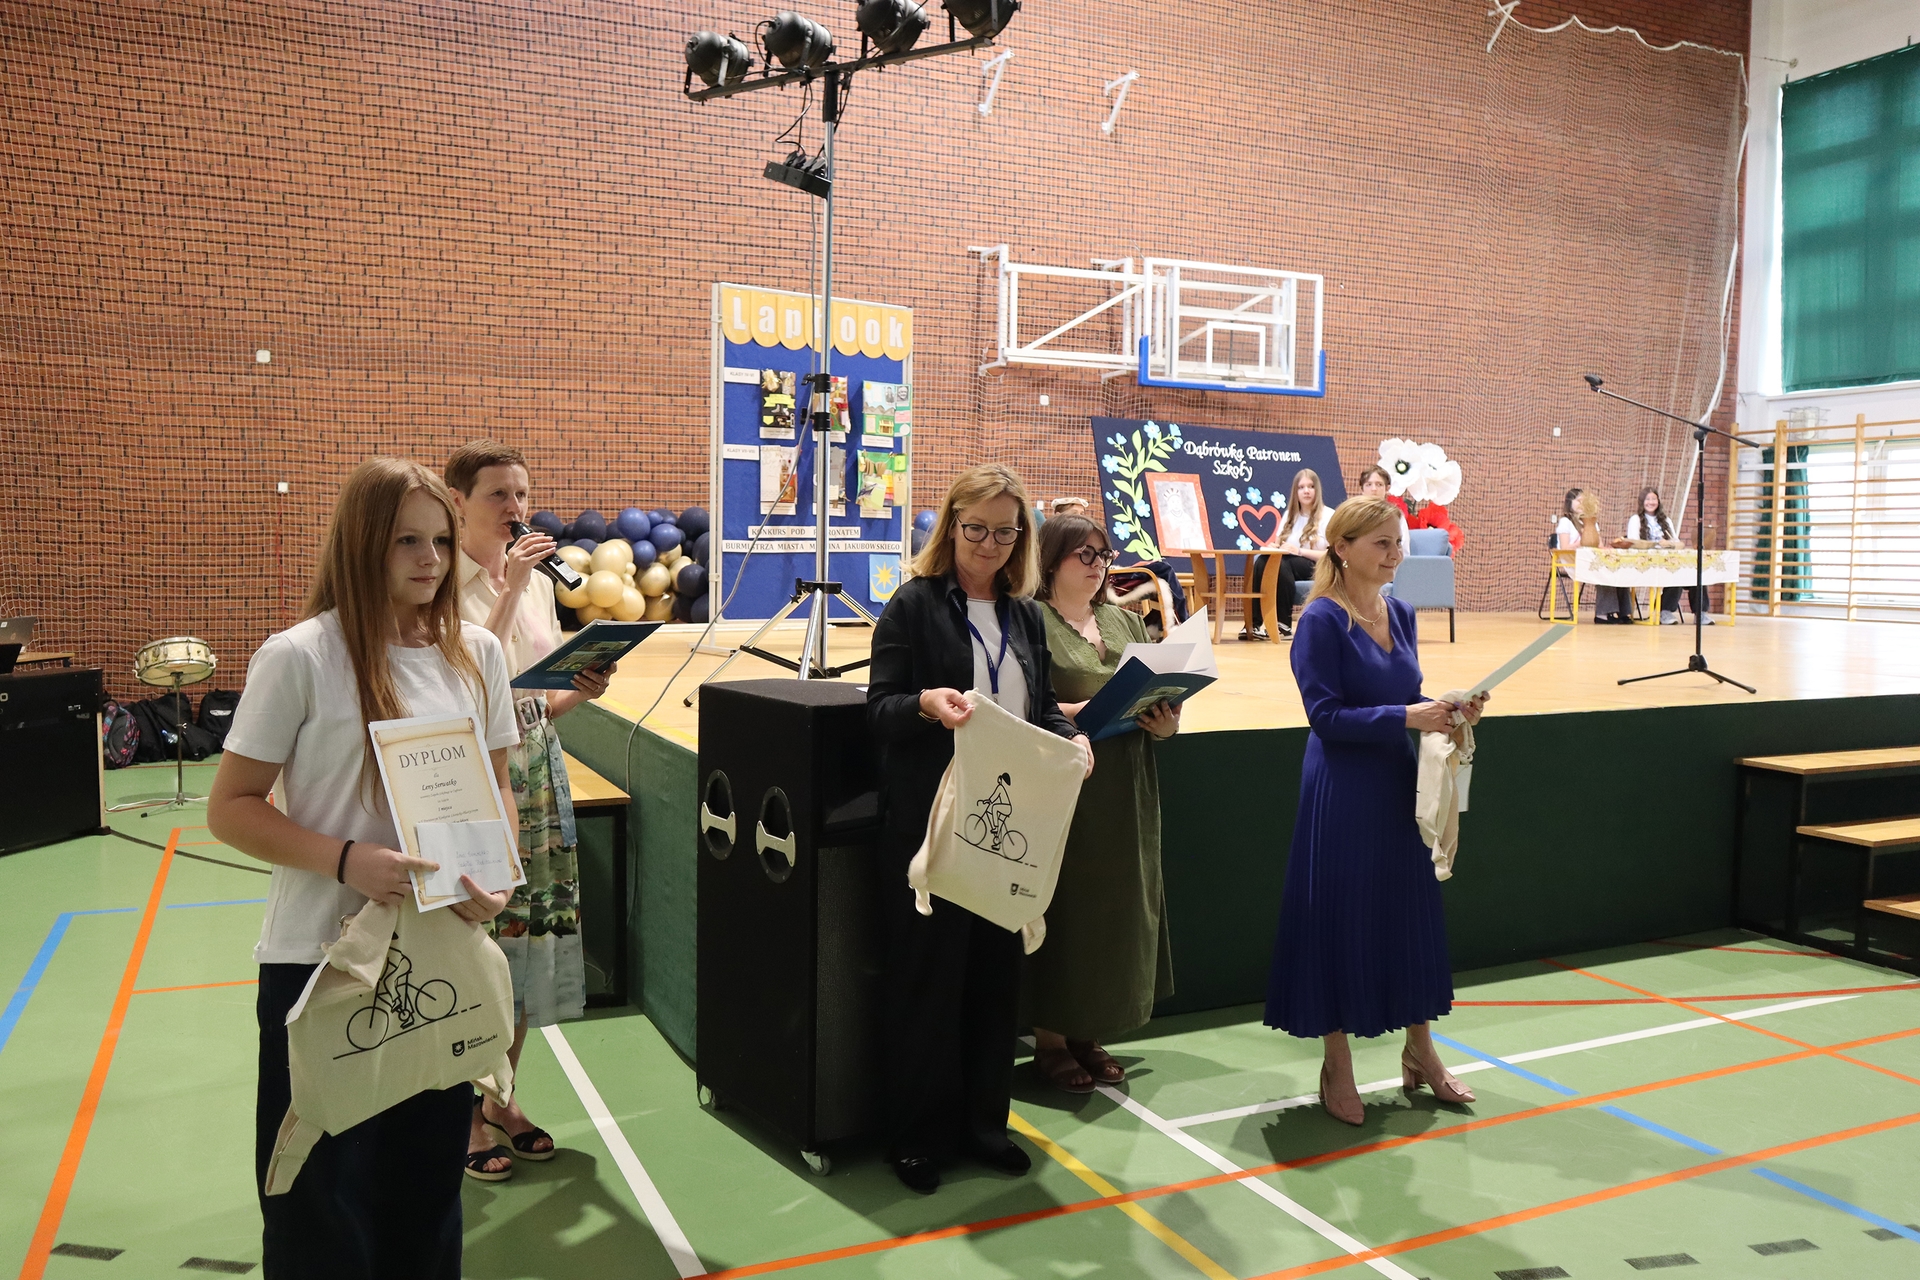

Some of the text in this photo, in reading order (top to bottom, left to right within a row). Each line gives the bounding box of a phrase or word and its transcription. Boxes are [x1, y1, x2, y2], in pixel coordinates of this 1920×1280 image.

[1184, 440, 1302, 462] Dąbrówka Patronem
[1212, 459, 1253, 482] Szkoły
[790, 528, 806, 536] POD
[844, 543, 901, 551] JAKUBOWSKIEGO
[398, 745, 466, 768] DYPLOM
